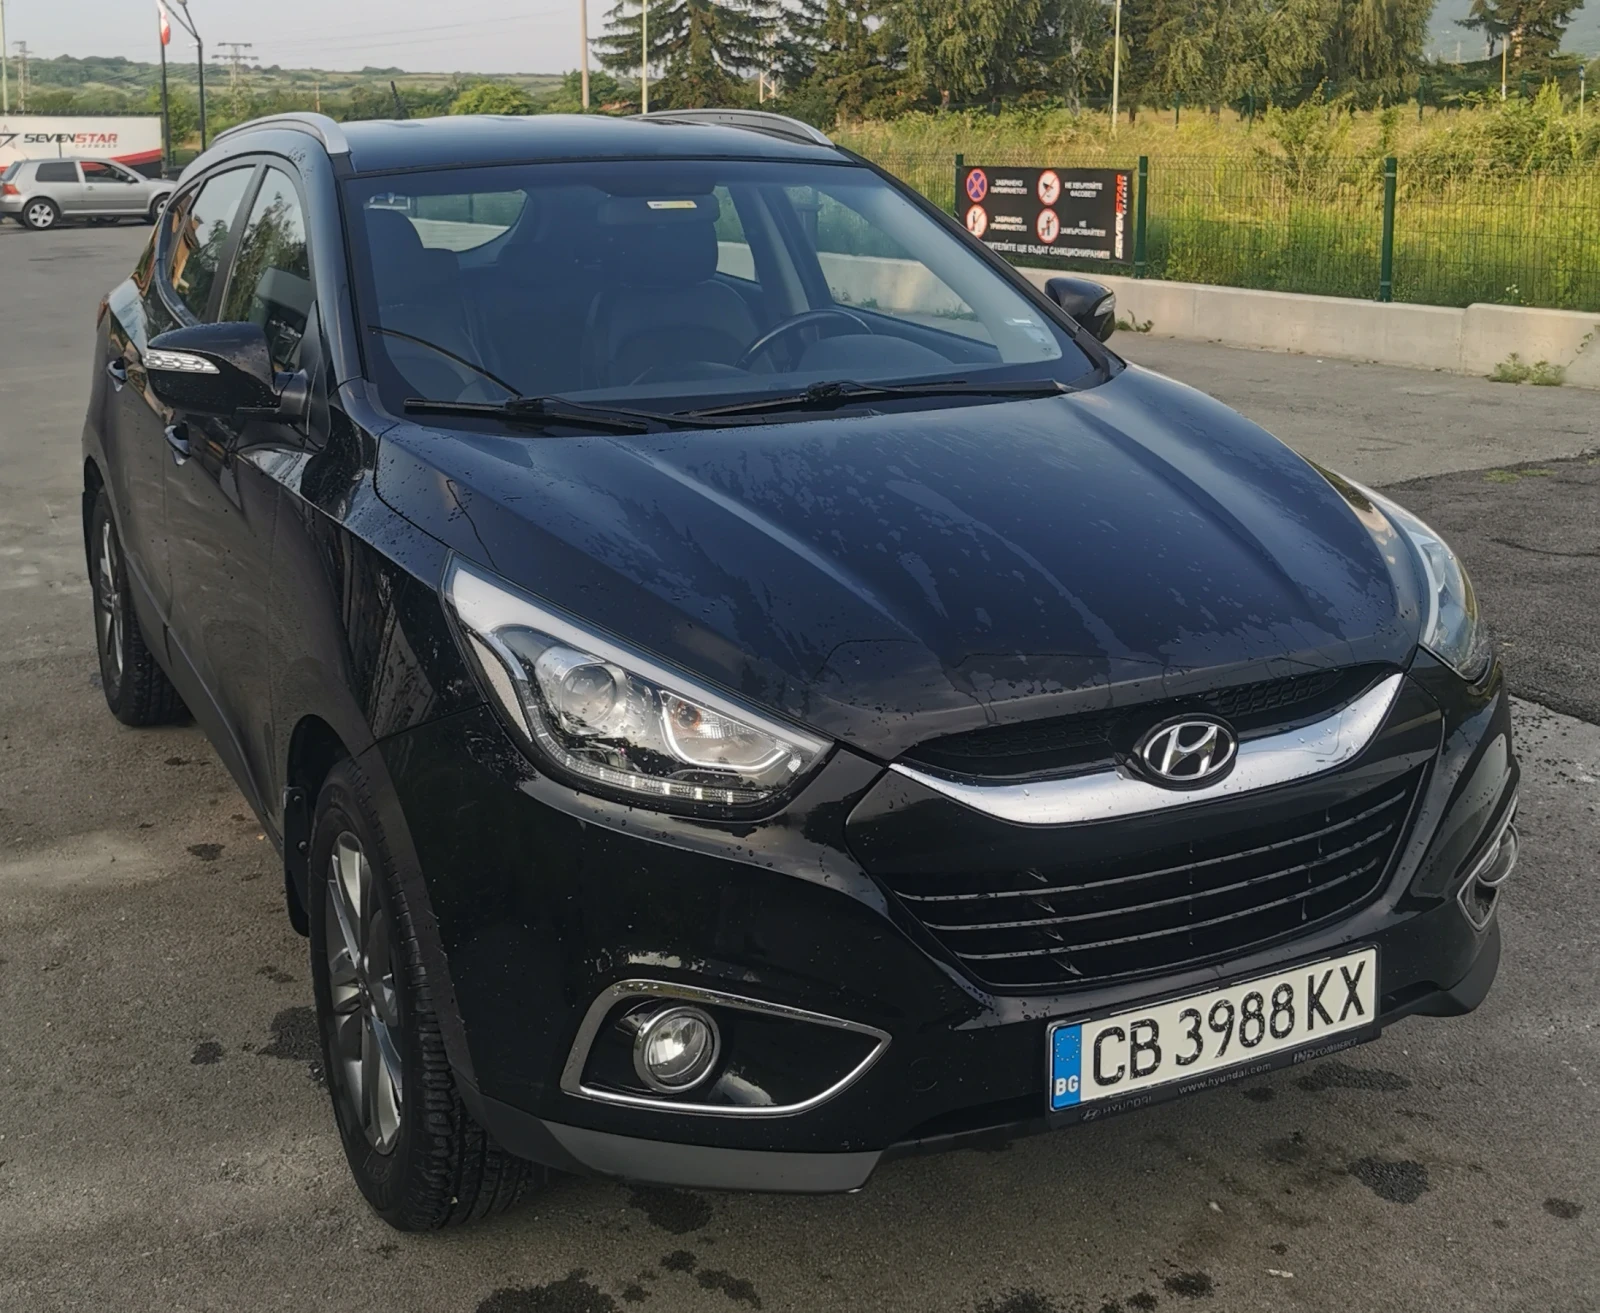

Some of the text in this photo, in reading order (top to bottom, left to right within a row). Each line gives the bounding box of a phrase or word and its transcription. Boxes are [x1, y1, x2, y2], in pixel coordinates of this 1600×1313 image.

[23, 133, 118, 143] SEVENSTAR
[1115, 174, 1124, 260] SEVENSTAR
[1093, 960, 1366, 1086] CB 3988 KX
[1055, 1077, 1079, 1096] BG
[1178, 1062, 1271, 1094] www.hyundai.com
